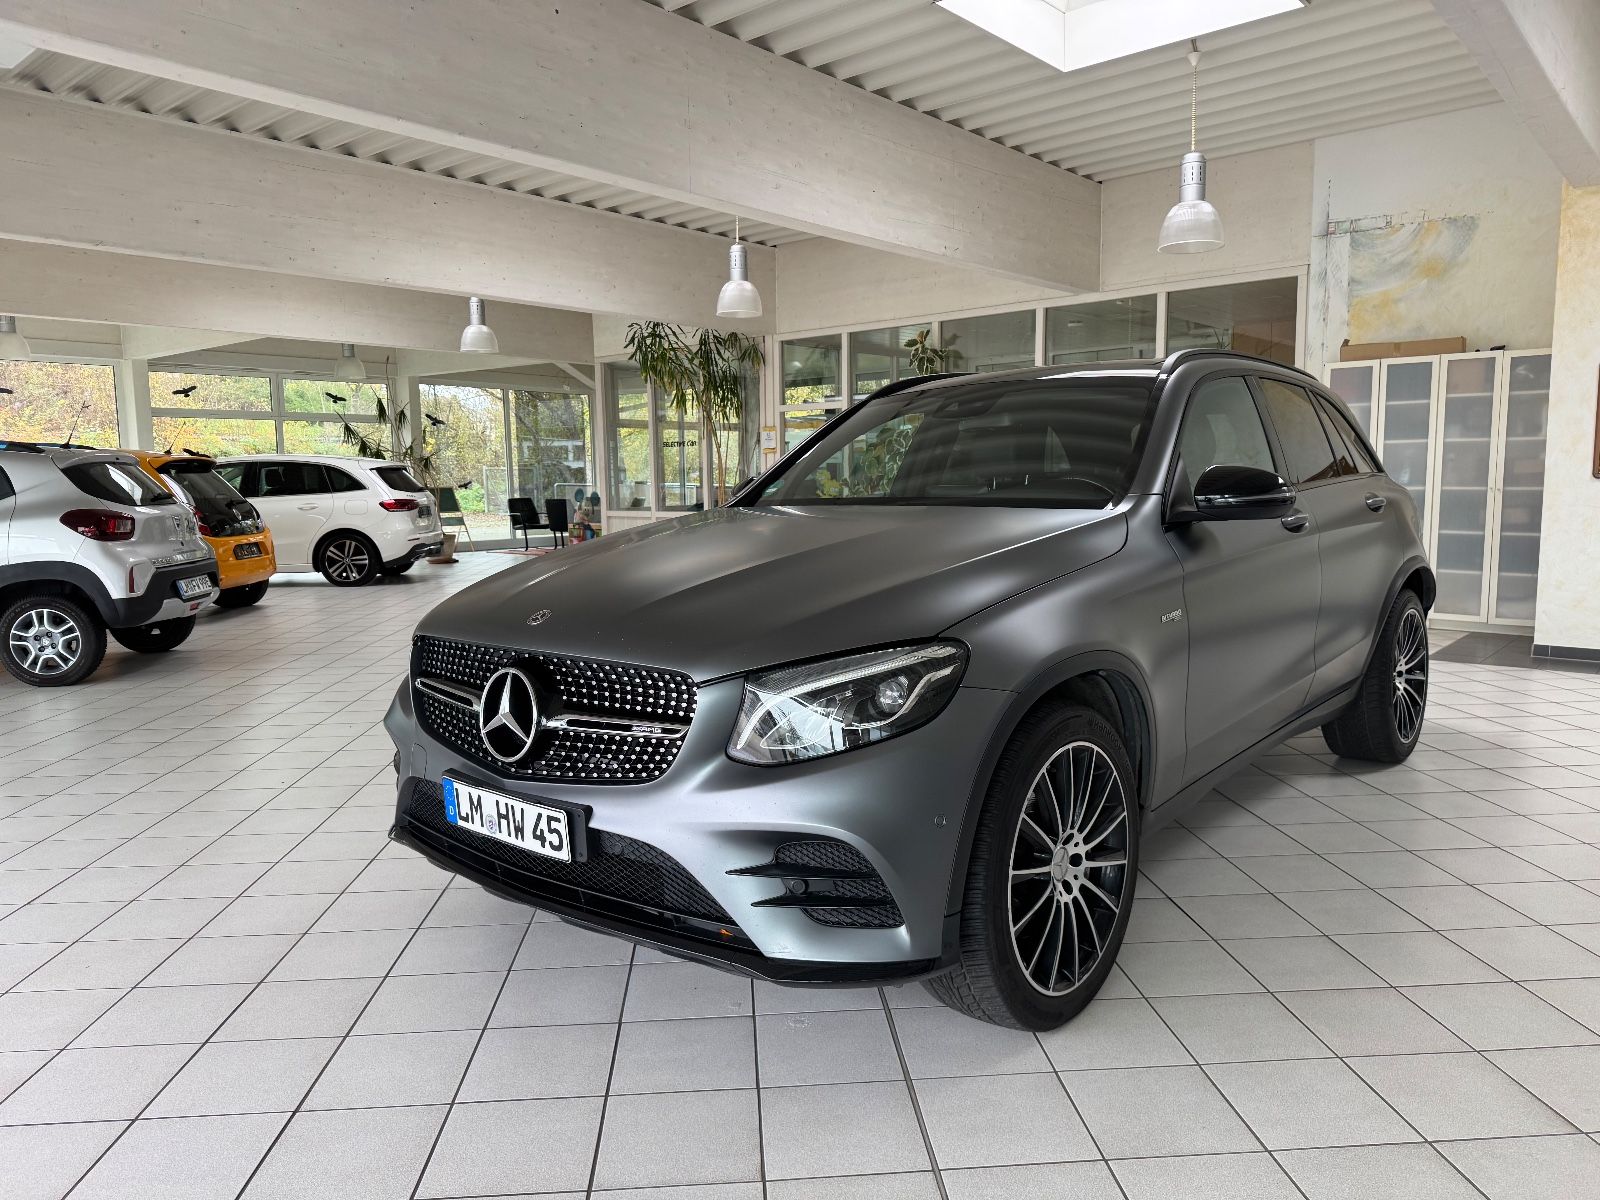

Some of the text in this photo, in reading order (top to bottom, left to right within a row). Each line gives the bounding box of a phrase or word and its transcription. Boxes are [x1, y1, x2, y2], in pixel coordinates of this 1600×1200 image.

[450, 806, 455, 815] D
[455, 787, 564, 852] LM HW 45
